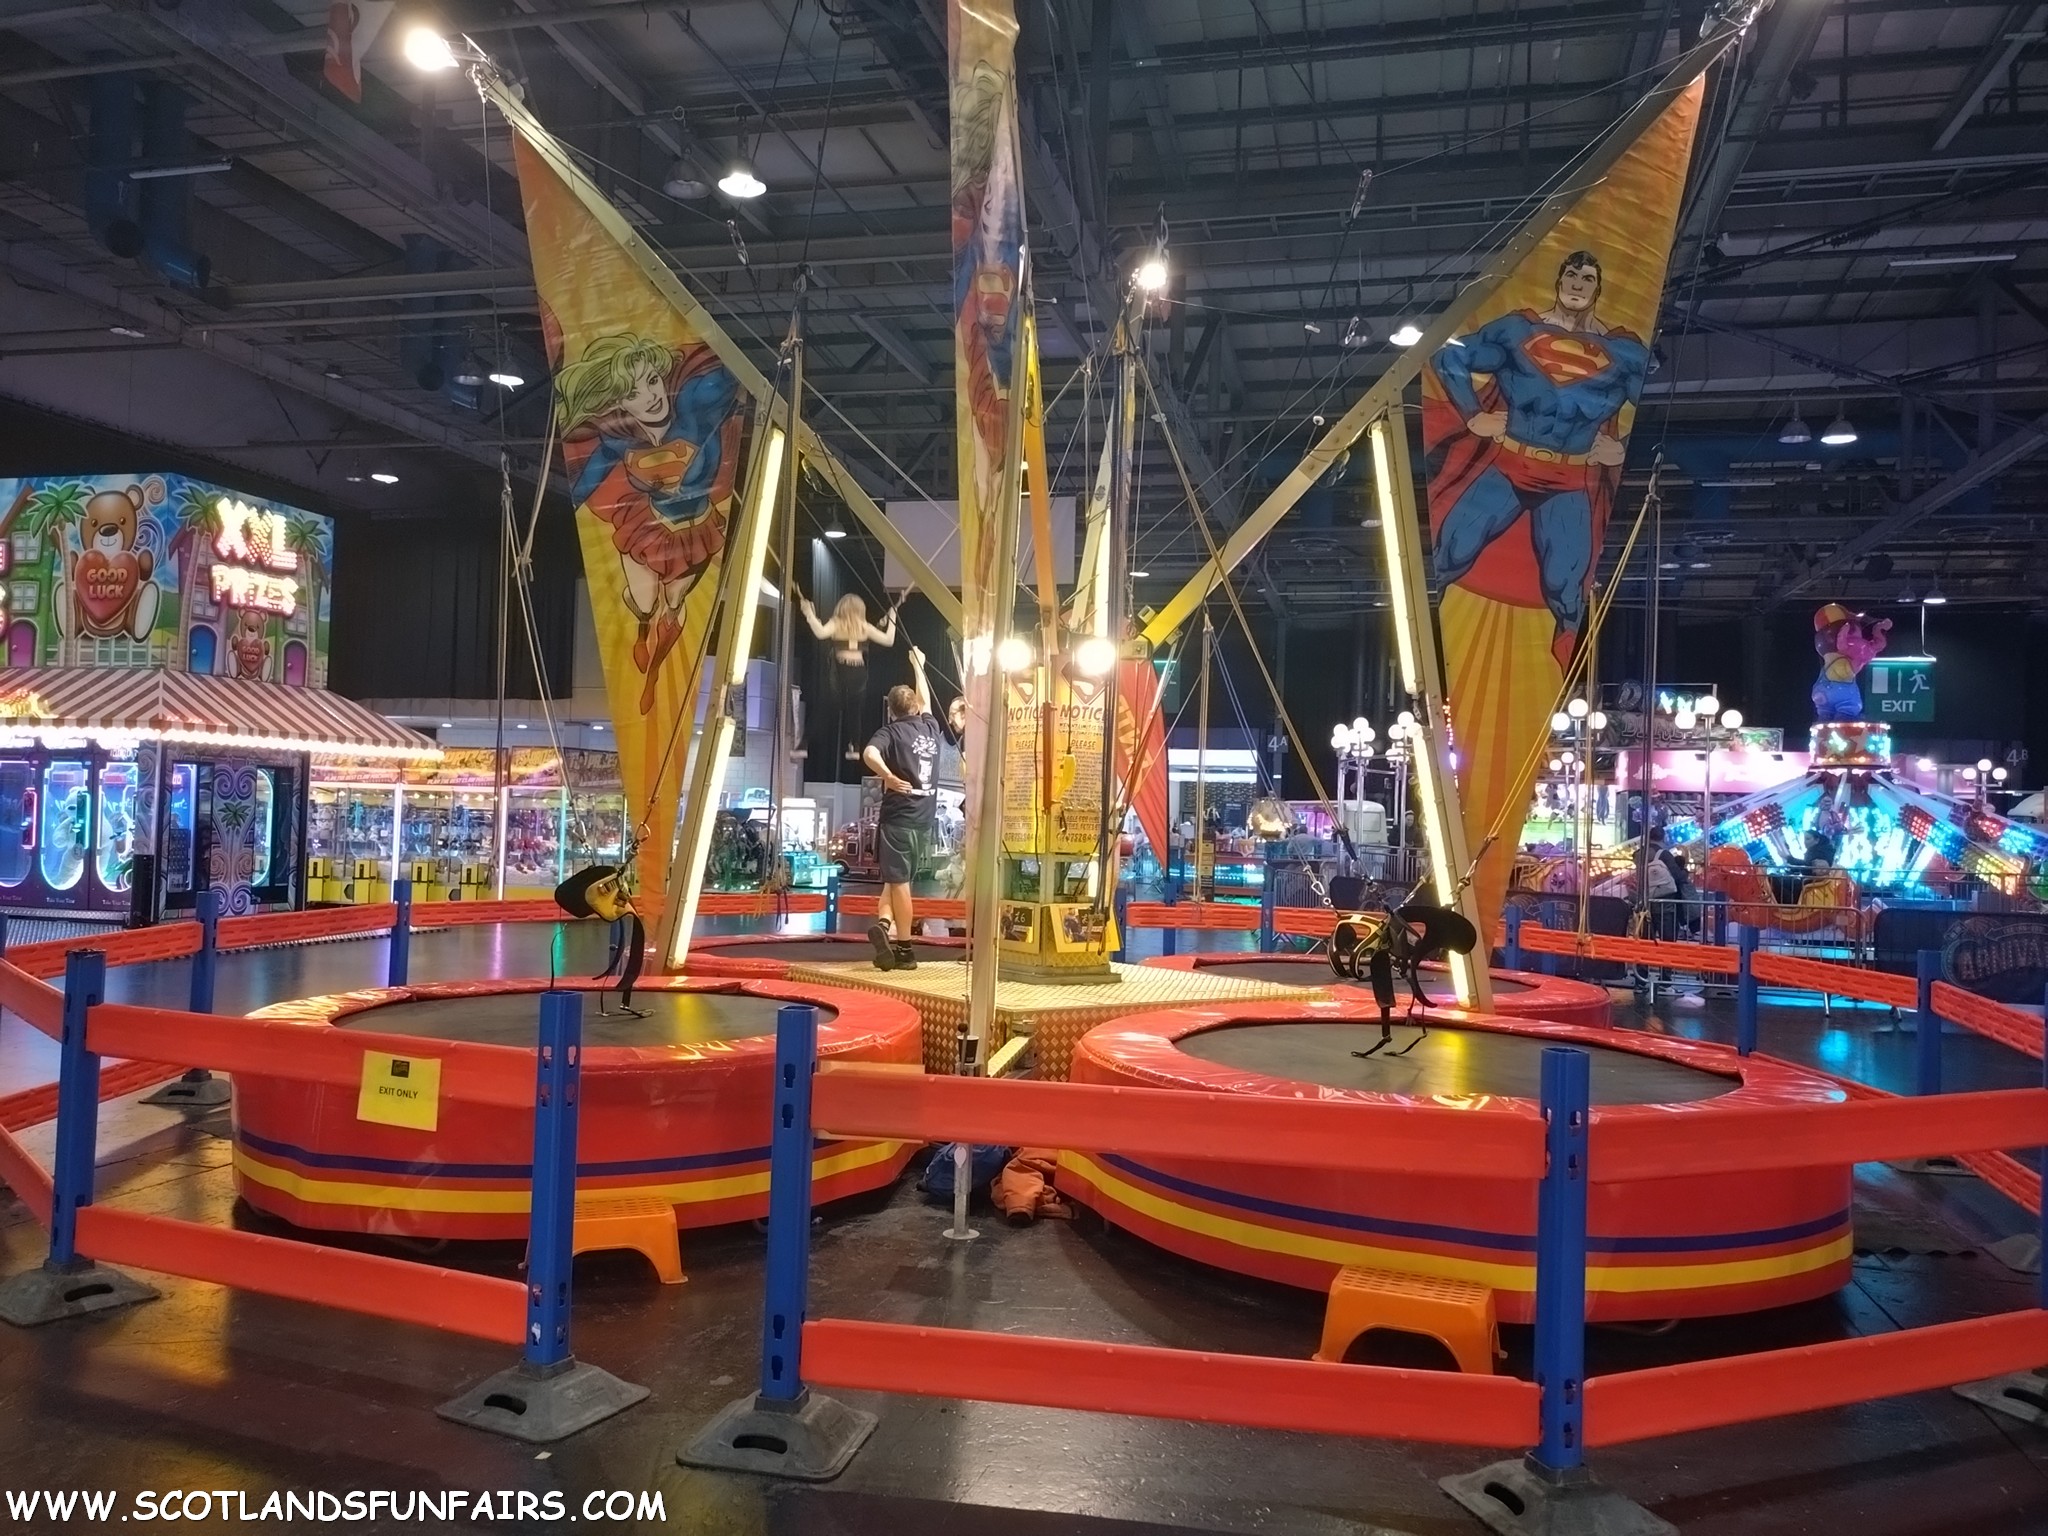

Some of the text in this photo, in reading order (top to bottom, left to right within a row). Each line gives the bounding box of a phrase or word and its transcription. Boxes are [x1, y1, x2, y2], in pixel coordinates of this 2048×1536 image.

[86, 567, 128, 583] GOOD
[88, 584, 124, 600] LUCK
[211, 564, 299, 617] PRIZES
[242, 645, 260, 655] GOOD
[242, 653, 259, 662] LUCK
[1060, 703, 1105, 721] NOTIC
[1881, 700, 1917, 713] EXIT
[1070, 739, 1096, 749] PLEASE
[1267, 735, 1288, 752] 4A
[379, 1086, 418, 1099] EXIT ONLY
